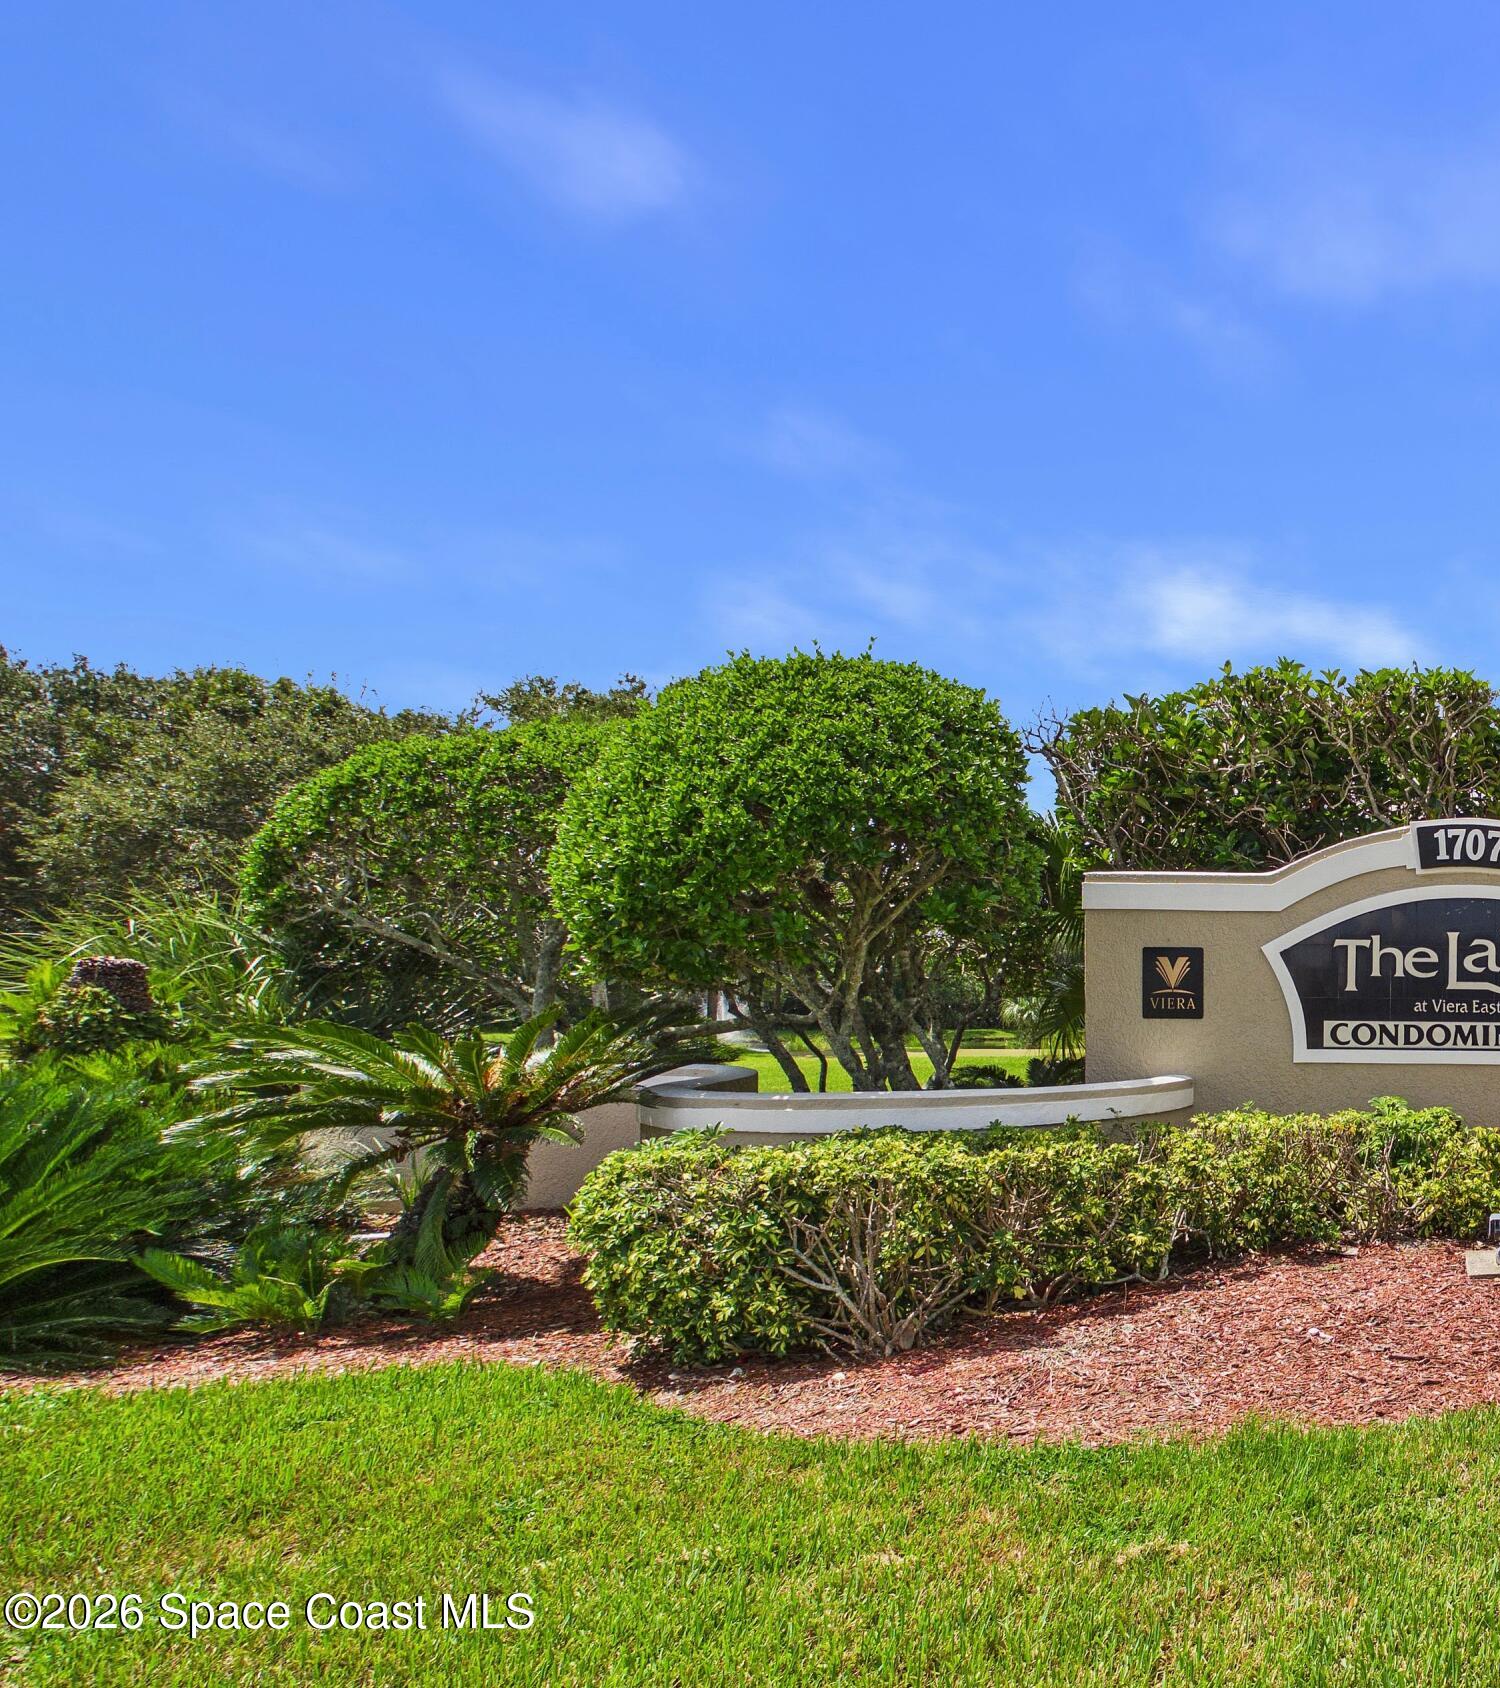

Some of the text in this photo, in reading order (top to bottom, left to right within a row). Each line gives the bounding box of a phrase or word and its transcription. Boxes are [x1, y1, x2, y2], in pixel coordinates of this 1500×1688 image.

[1333, 934, 1439, 992] The
[1149, 997, 1196, 1010] VIERA
[1413, 1000, 1428, 1013] at
[1432, 999, 1468, 1013] Viera
